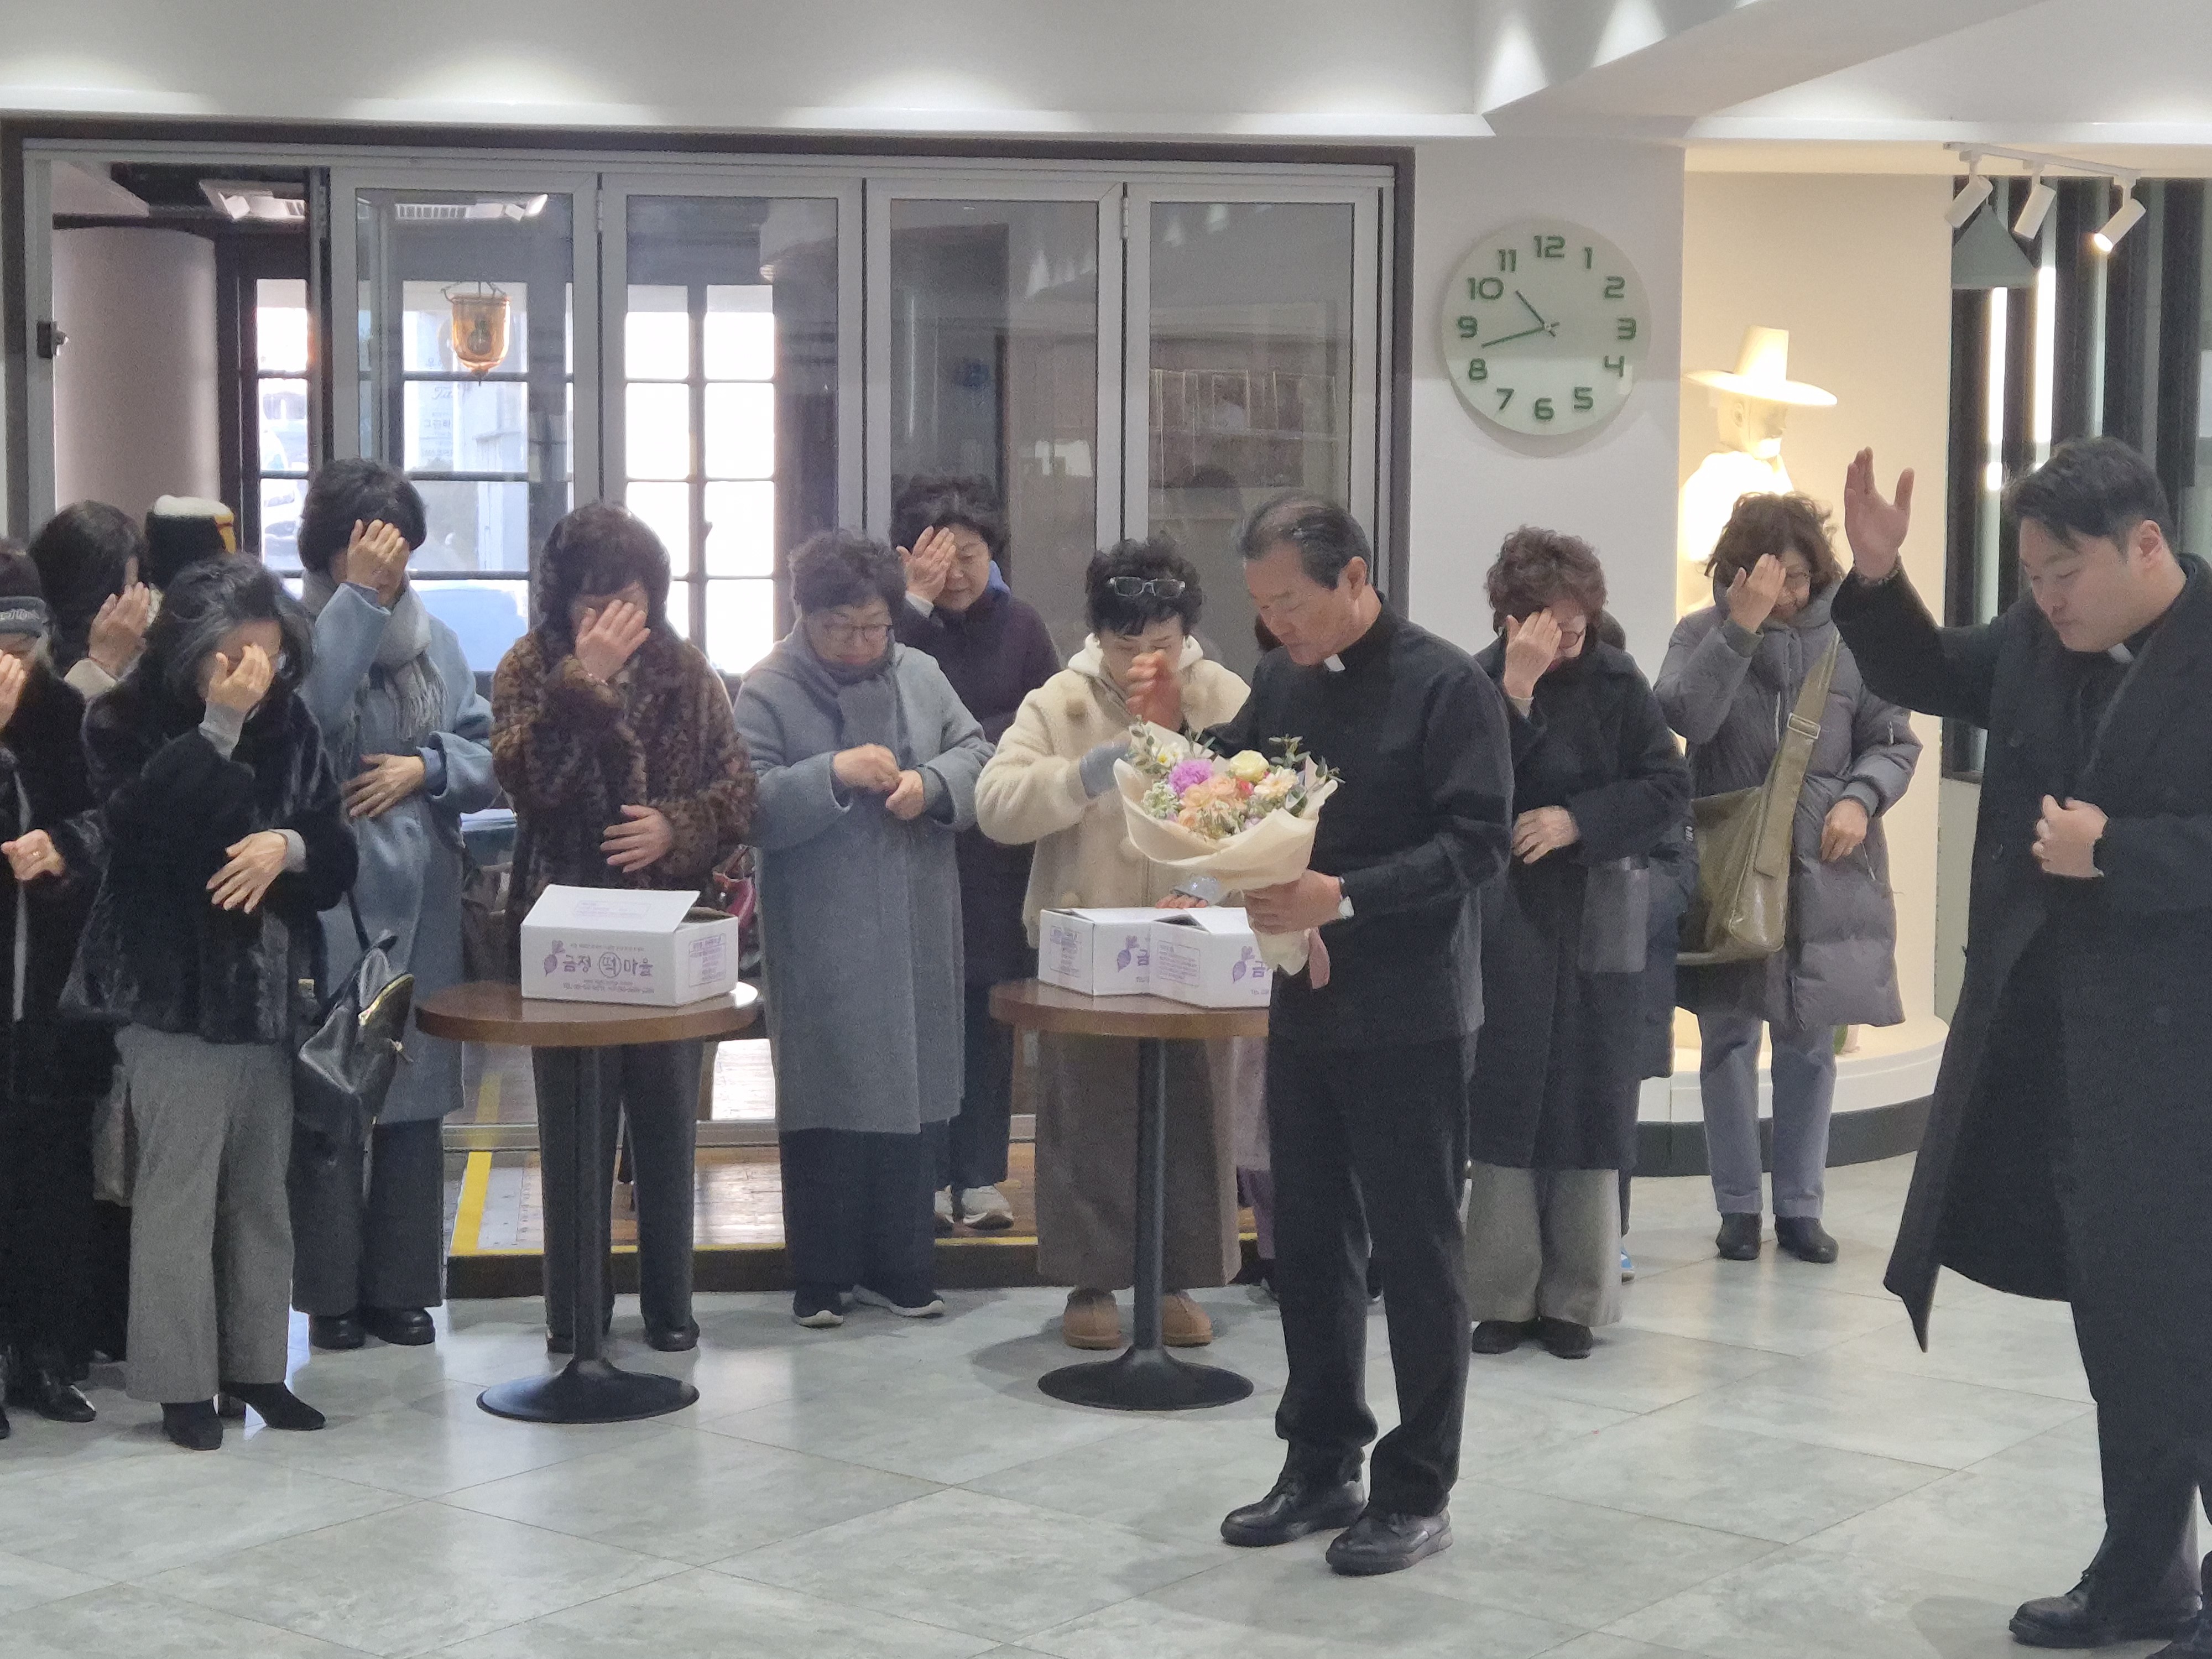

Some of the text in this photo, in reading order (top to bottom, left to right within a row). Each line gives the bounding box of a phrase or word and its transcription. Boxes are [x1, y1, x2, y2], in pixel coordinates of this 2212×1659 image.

[1533, 234, 1565, 258] 12
[1584, 246, 1593, 269] 1
[1497, 248, 1517, 272] 11
[1467, 276, 1505, 300] 10
[1604, 275, 1626, 299] 2
[1457, 315, 1478, 338] 9
[1617, 317, 1637, 340] 3
[1468, 358, 1488, 381] 8
[1604, 355, 1625, 378] 4
[1496, 388, 1515, 411] 7
[1533, 397, 1554, 421] 6
[1573, 387, 1594, 410] 5
[563, 954, 592, 973] 금정
